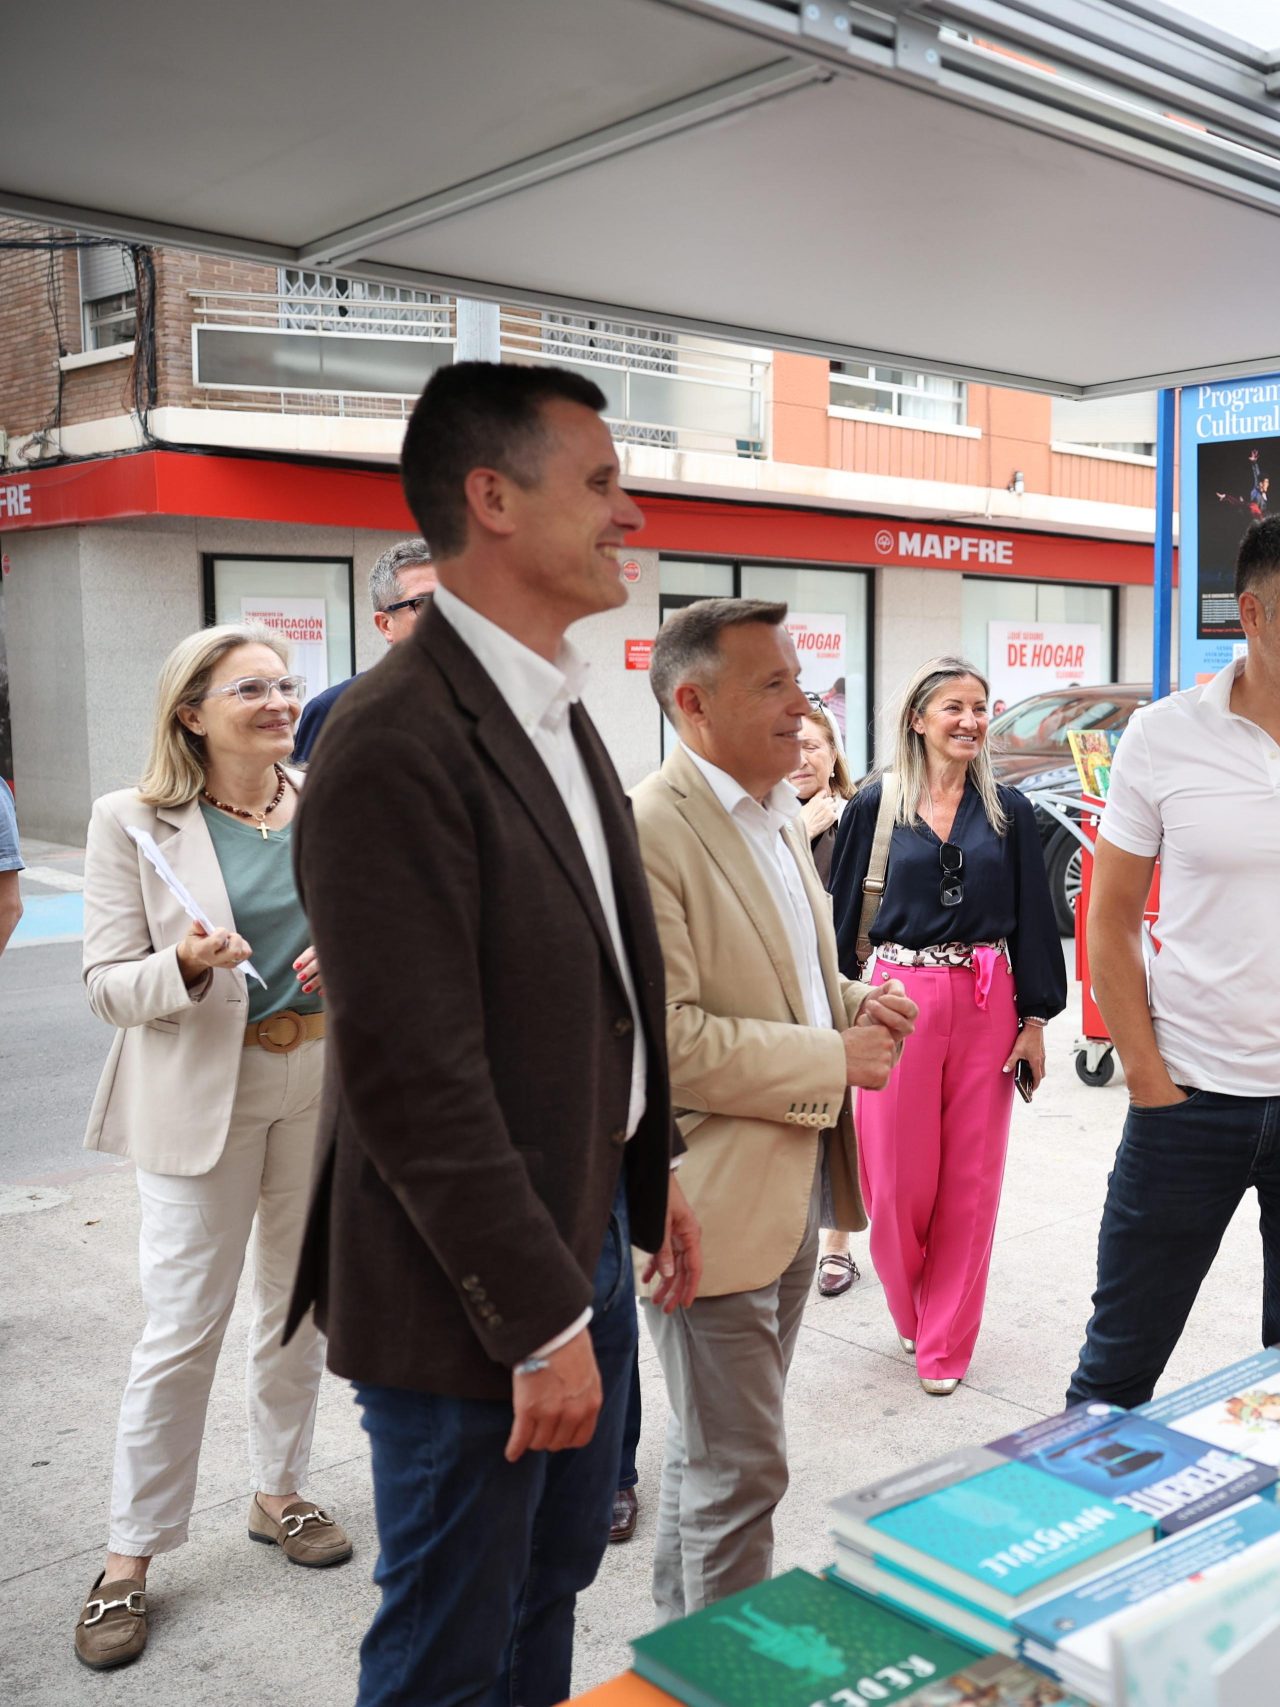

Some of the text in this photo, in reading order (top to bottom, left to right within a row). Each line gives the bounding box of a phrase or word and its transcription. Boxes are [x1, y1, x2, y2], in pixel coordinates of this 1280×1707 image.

[1196, 405, 1280, 438] Cultural
[898, 531, 1013, 565] MAPFRE
[796, 633, 842, 651] HOGAR
[1007, 643, 1084, 668] DE HOGAR
[807, 1654, 937, 1707] REDE
